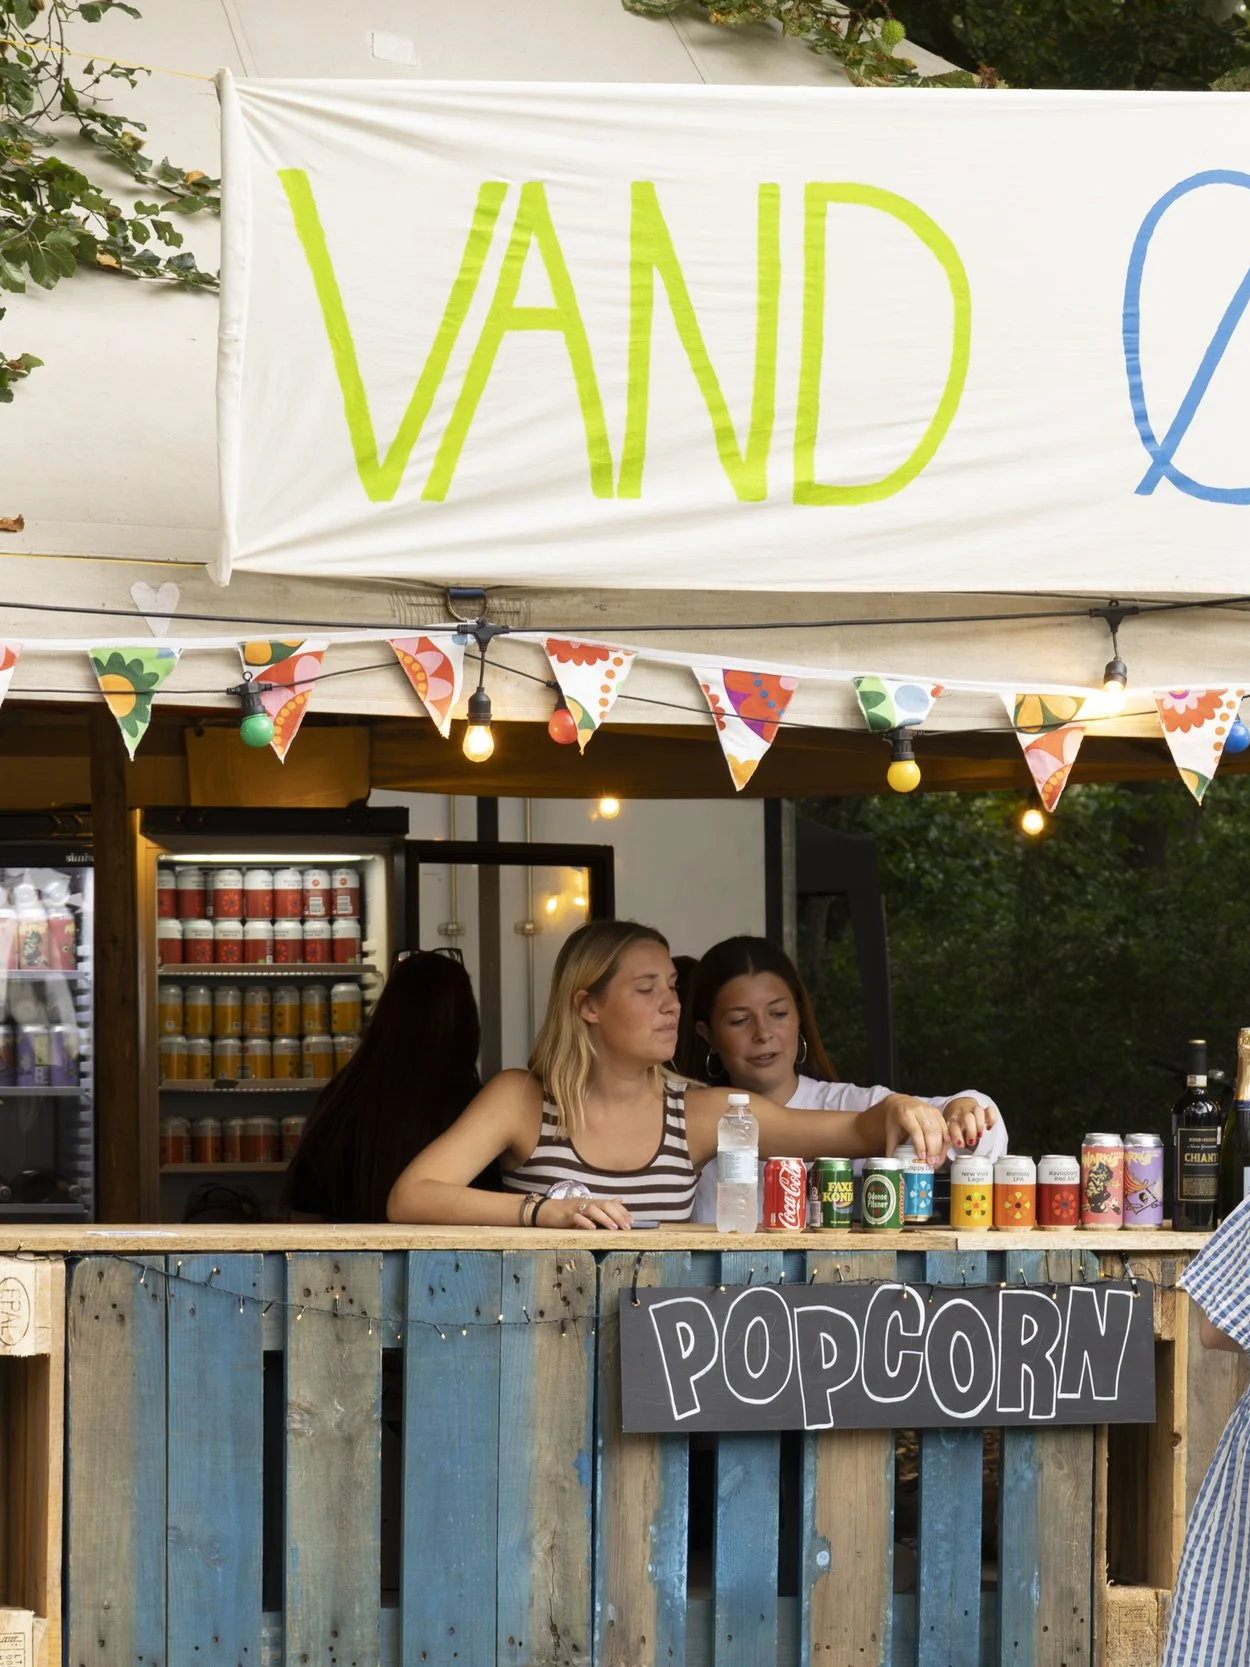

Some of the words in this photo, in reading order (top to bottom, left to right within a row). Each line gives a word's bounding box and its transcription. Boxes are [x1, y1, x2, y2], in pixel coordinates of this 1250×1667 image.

[277, 168, 972, 506] VAND
[827, 1182, 854, 1192] FAXE
[649, 1284, 1134, 1430] POPCORN
